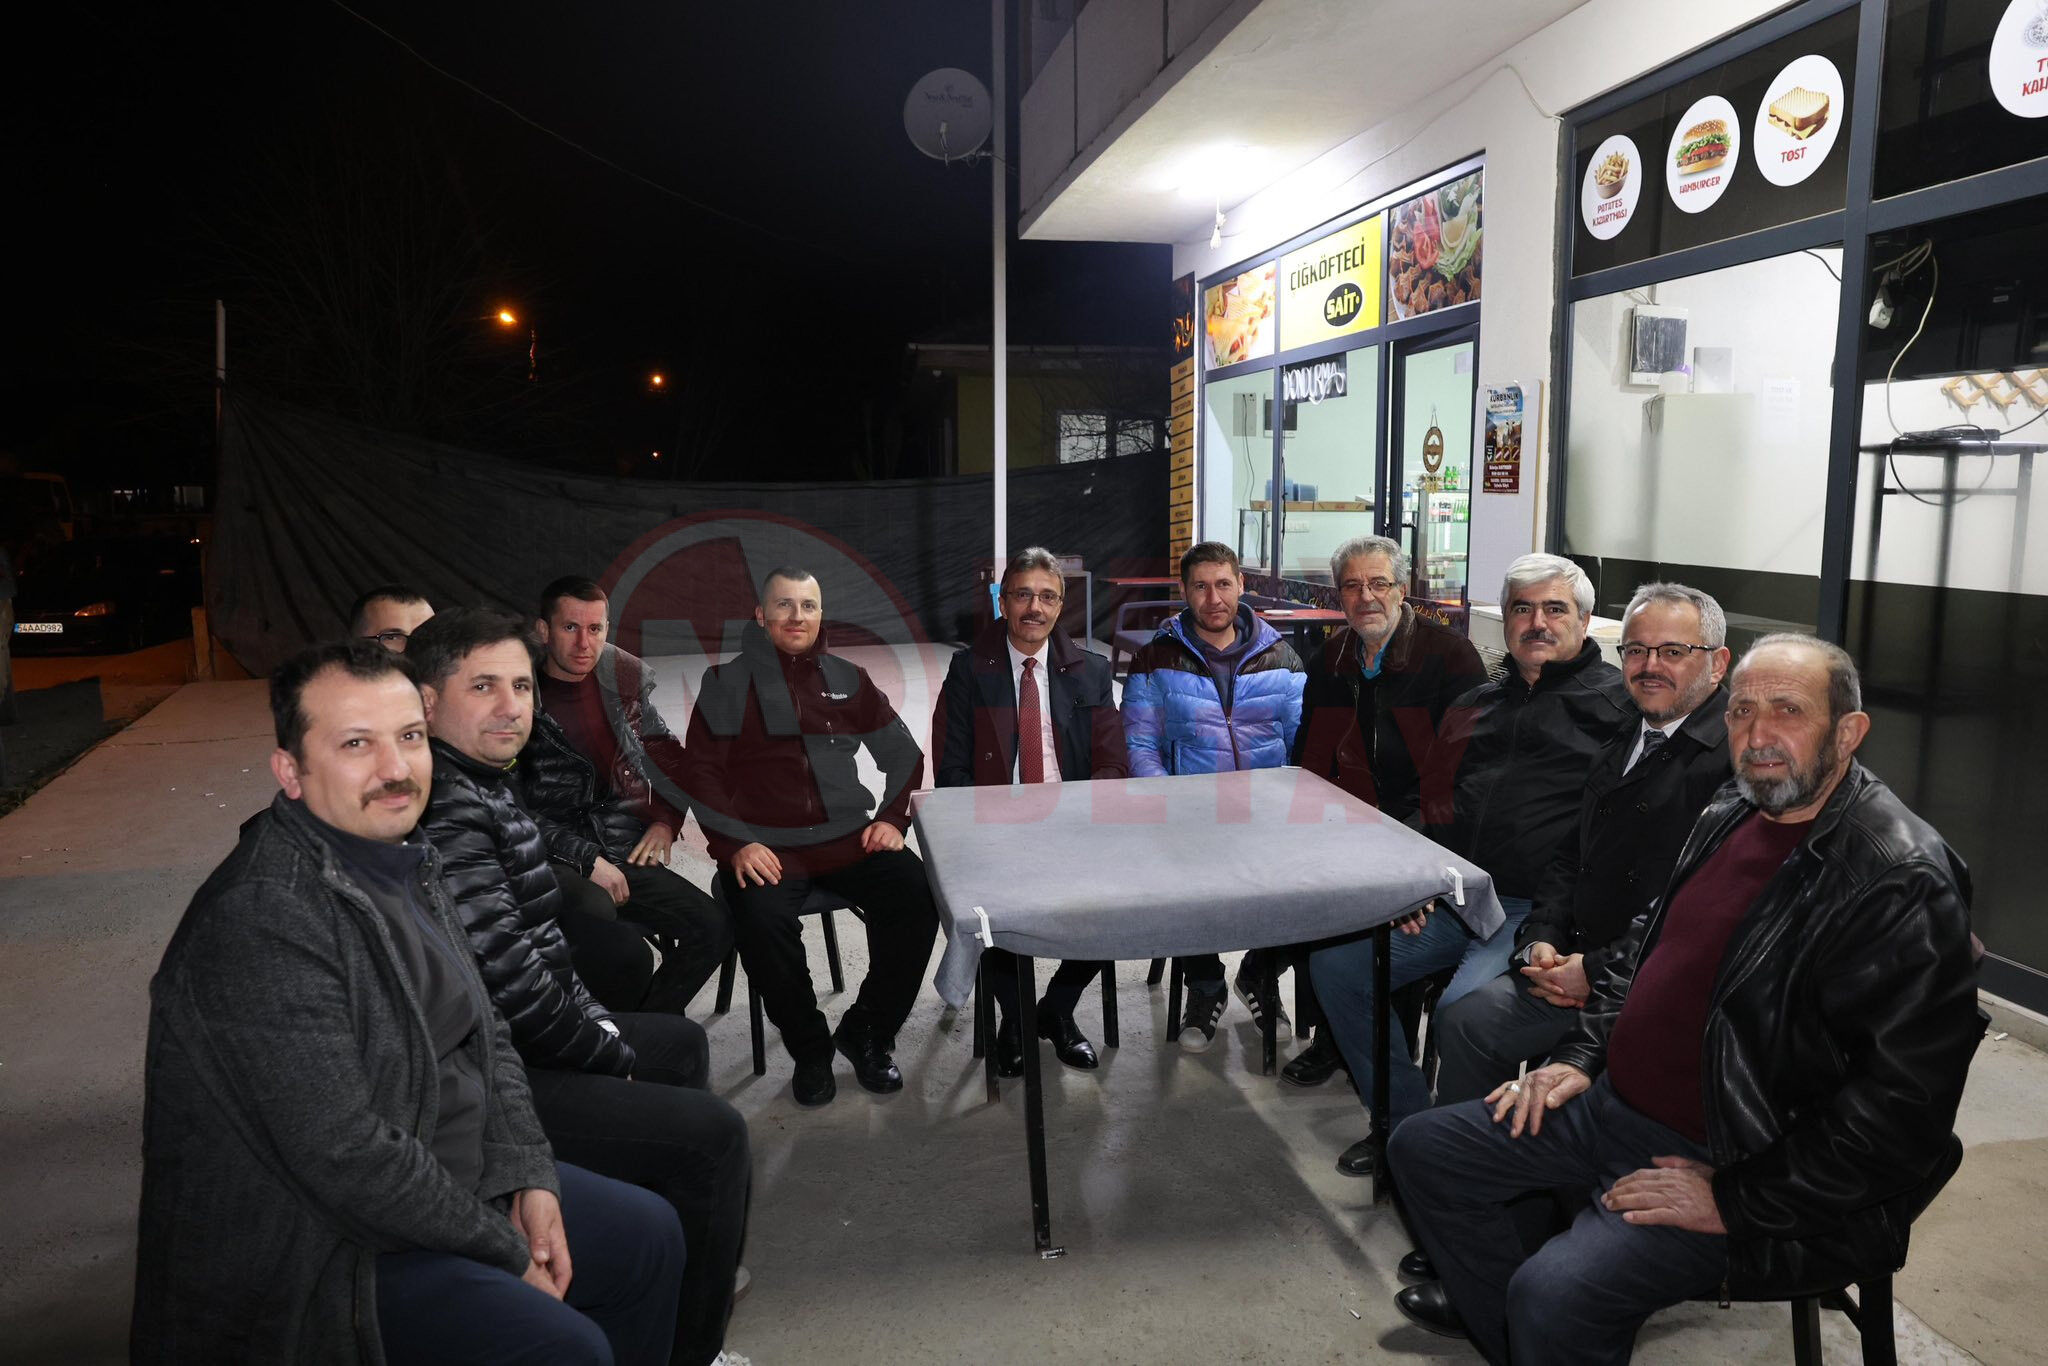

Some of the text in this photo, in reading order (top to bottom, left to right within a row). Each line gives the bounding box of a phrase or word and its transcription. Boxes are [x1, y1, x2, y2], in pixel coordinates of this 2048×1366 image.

[1781, 146, 1808, 163] TOST
[1680, 176, 1721, 195] HAMBURGER
[1597, 198, 1623, 214] PATATES
